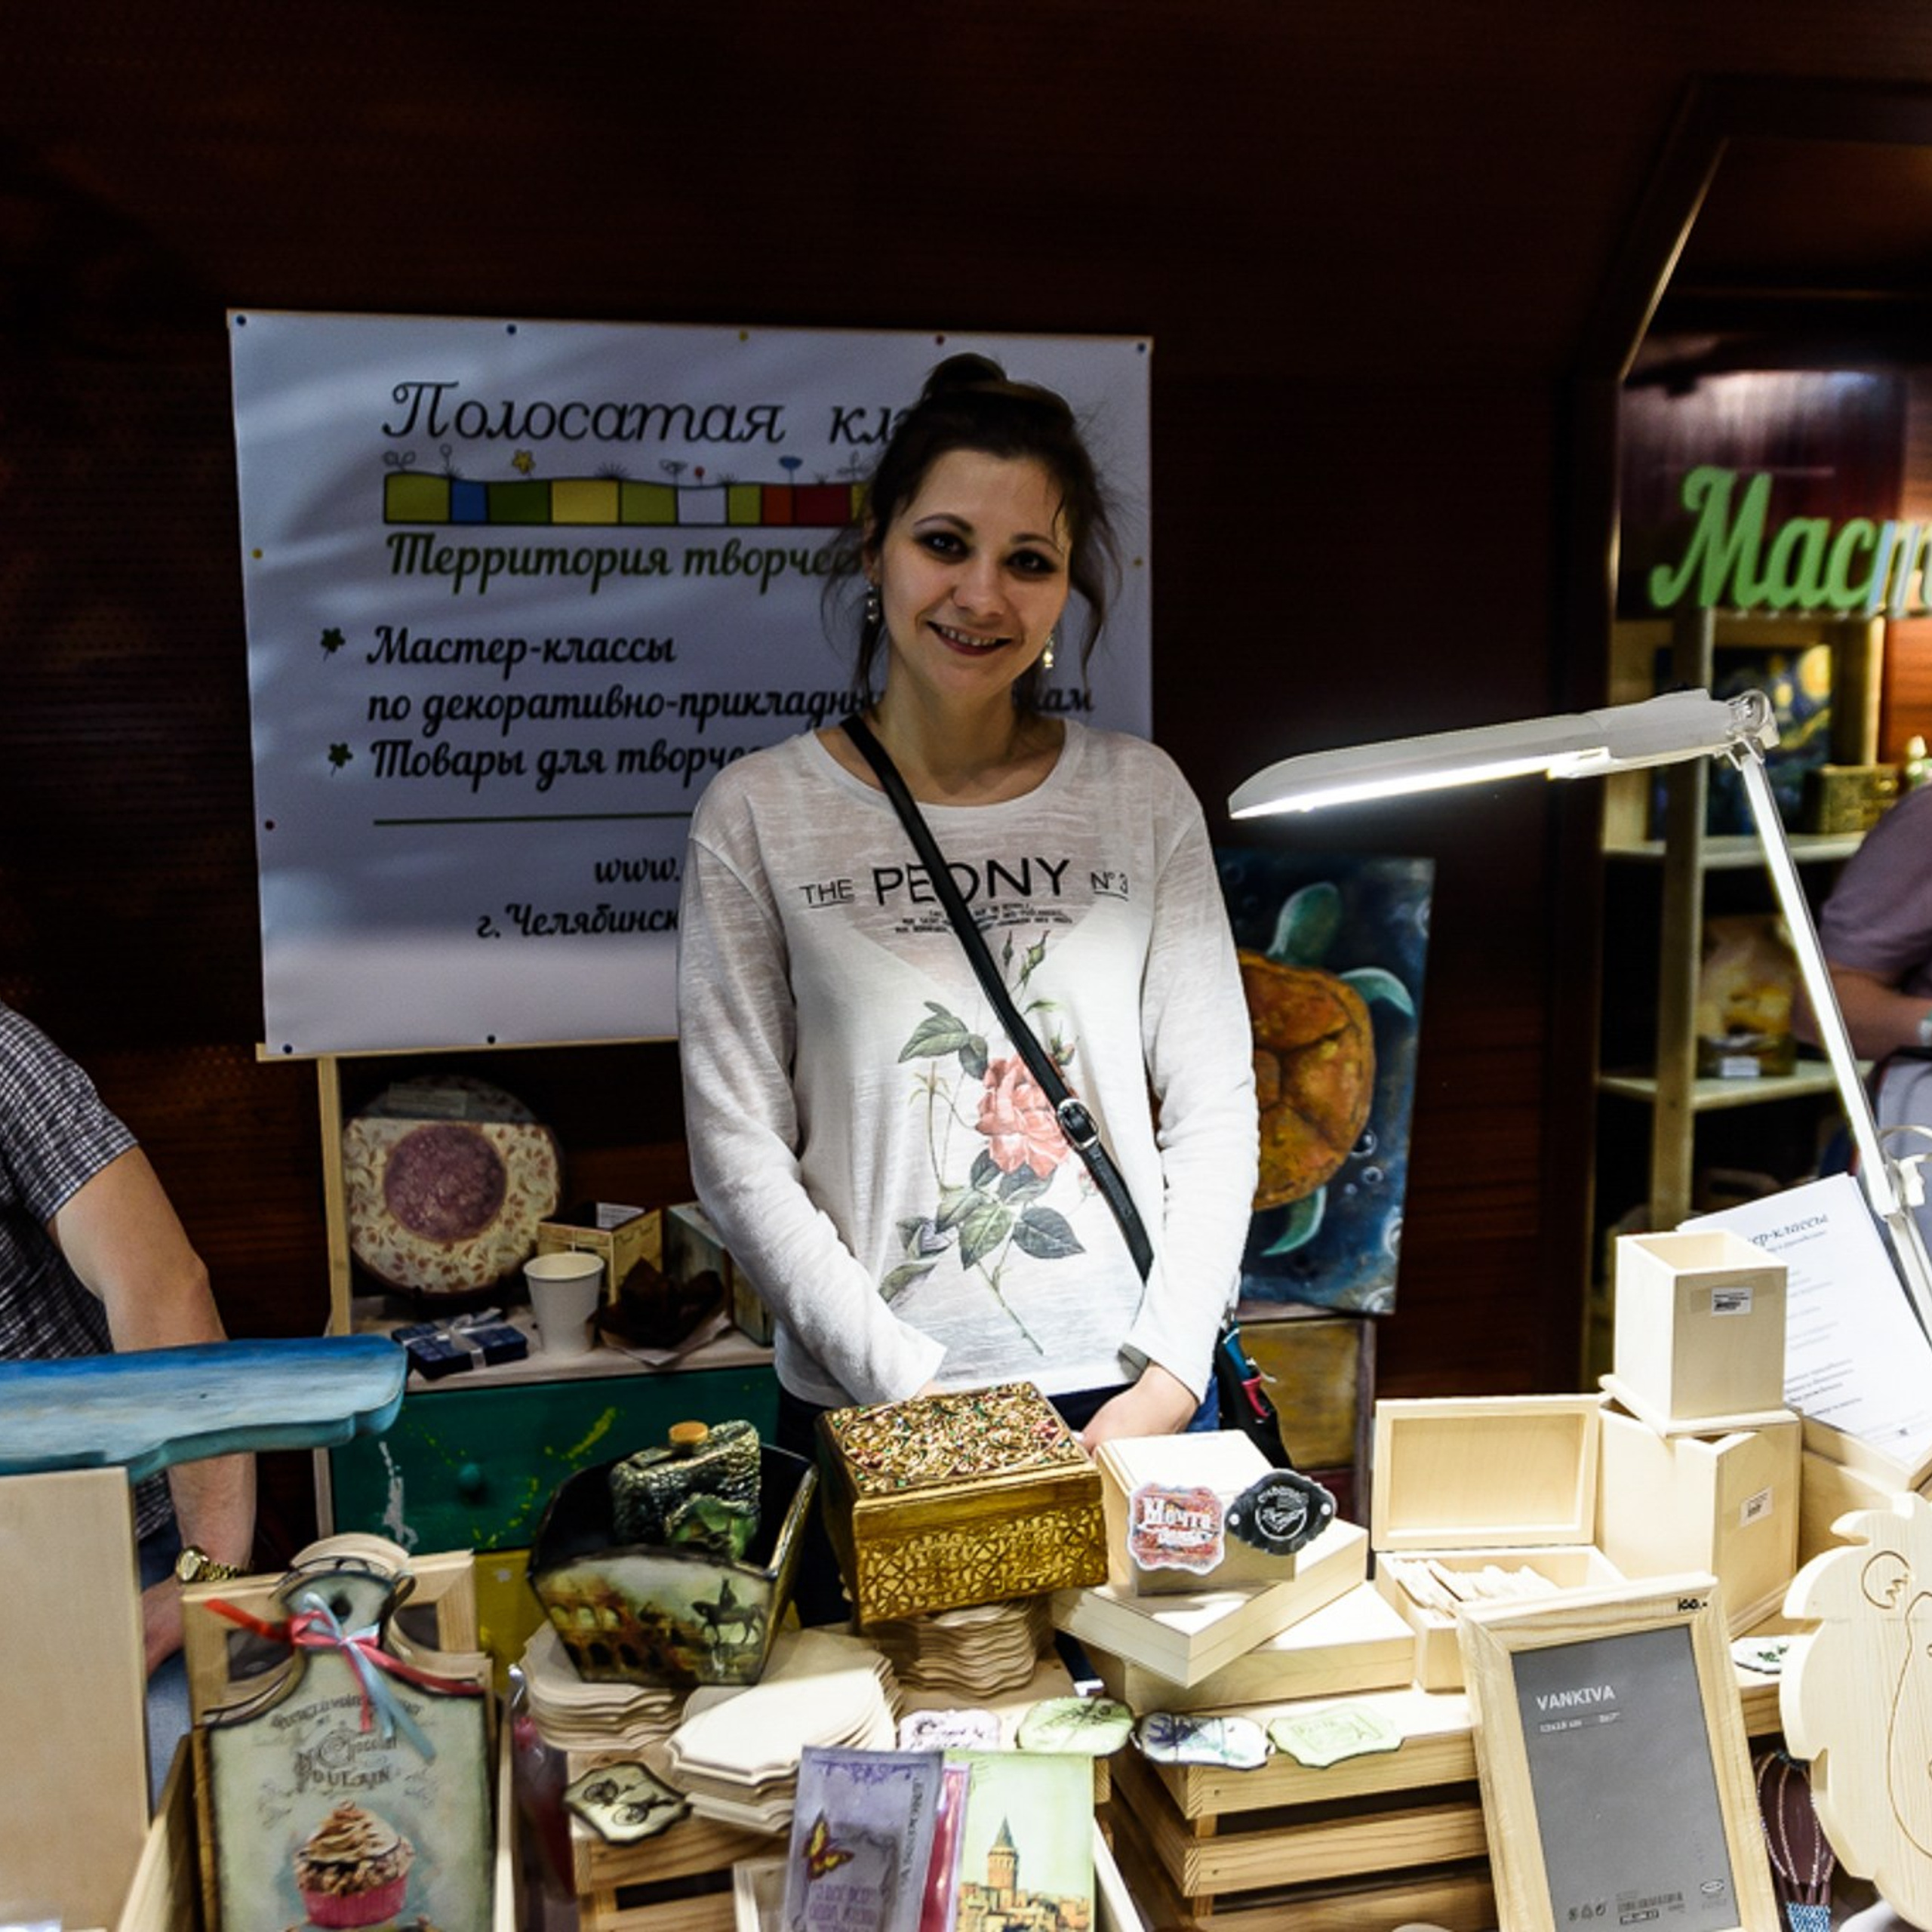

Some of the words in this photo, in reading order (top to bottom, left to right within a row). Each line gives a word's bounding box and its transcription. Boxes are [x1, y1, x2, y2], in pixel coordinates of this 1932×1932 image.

[382, 382, 785, 442] Полосатая
[829, 405, 907, 444] кл
[386, 533, 672, 595] Территория
[367, 626, 676, 680] Мастер-классы
[368, 694, 411, 722] по
[423, 684, 875, 738] декоративно-прикладны
[370, 739, 526, 793] Товары
[536, 753, 608, 792] для
[615, 739, 763, 788] творче
[594, 857, 680, 883] www.
[799, 878, 854, 905] THE
[477, 914, 501, 938] г.
[505, 903, 678, 937] Челябинск
[1748, 1213, 1829, 1247] ер-классы
[1536, 1684, 1617, 1712] VANKIVA
